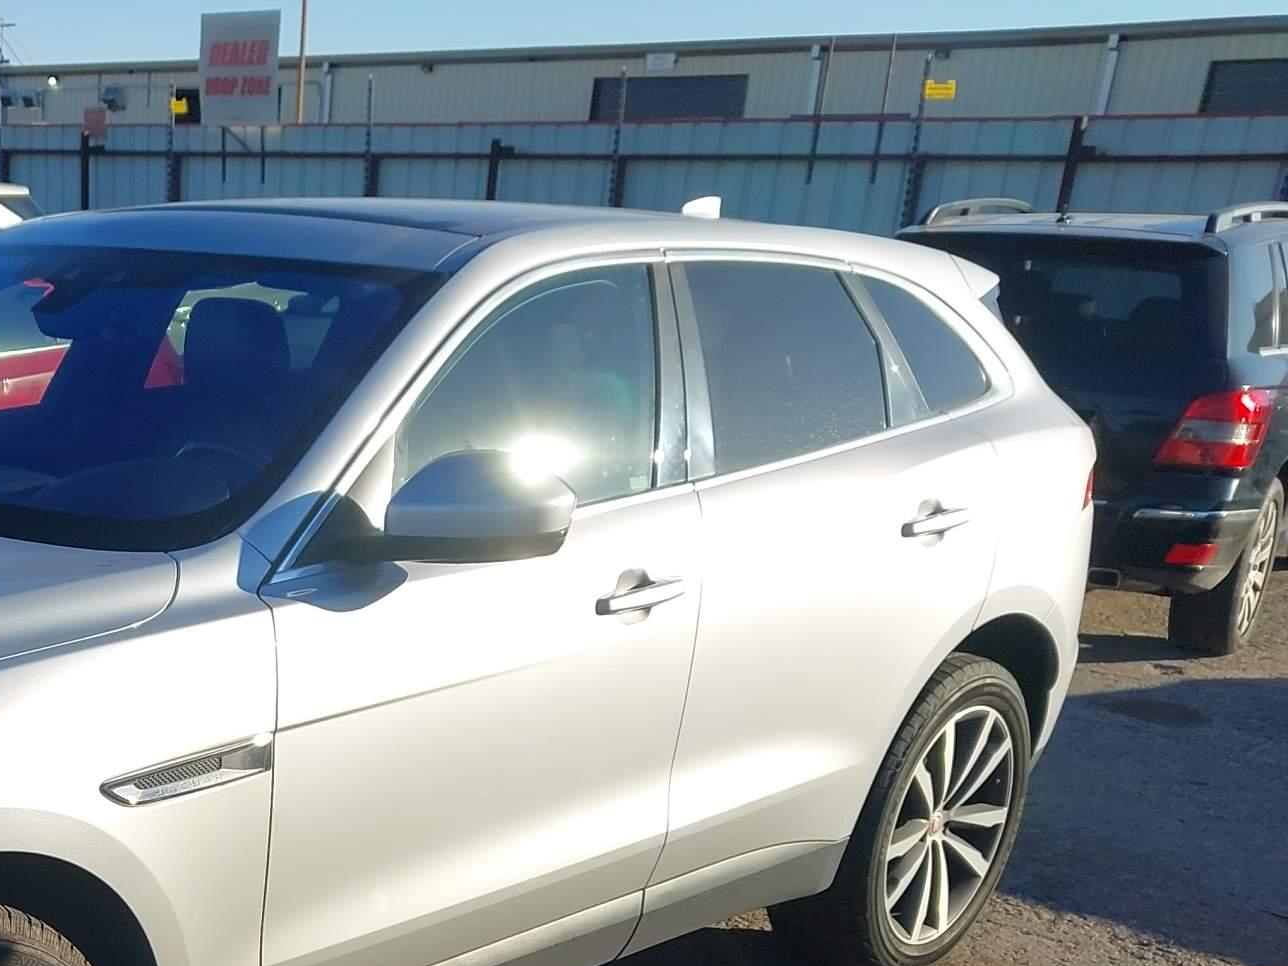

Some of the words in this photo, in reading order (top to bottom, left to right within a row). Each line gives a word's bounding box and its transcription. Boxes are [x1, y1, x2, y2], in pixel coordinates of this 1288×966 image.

[208, 40, 270, 67] DEALER
[206, 76, 238, 96] DROP
[240, 75, 271, 96] ZONE
